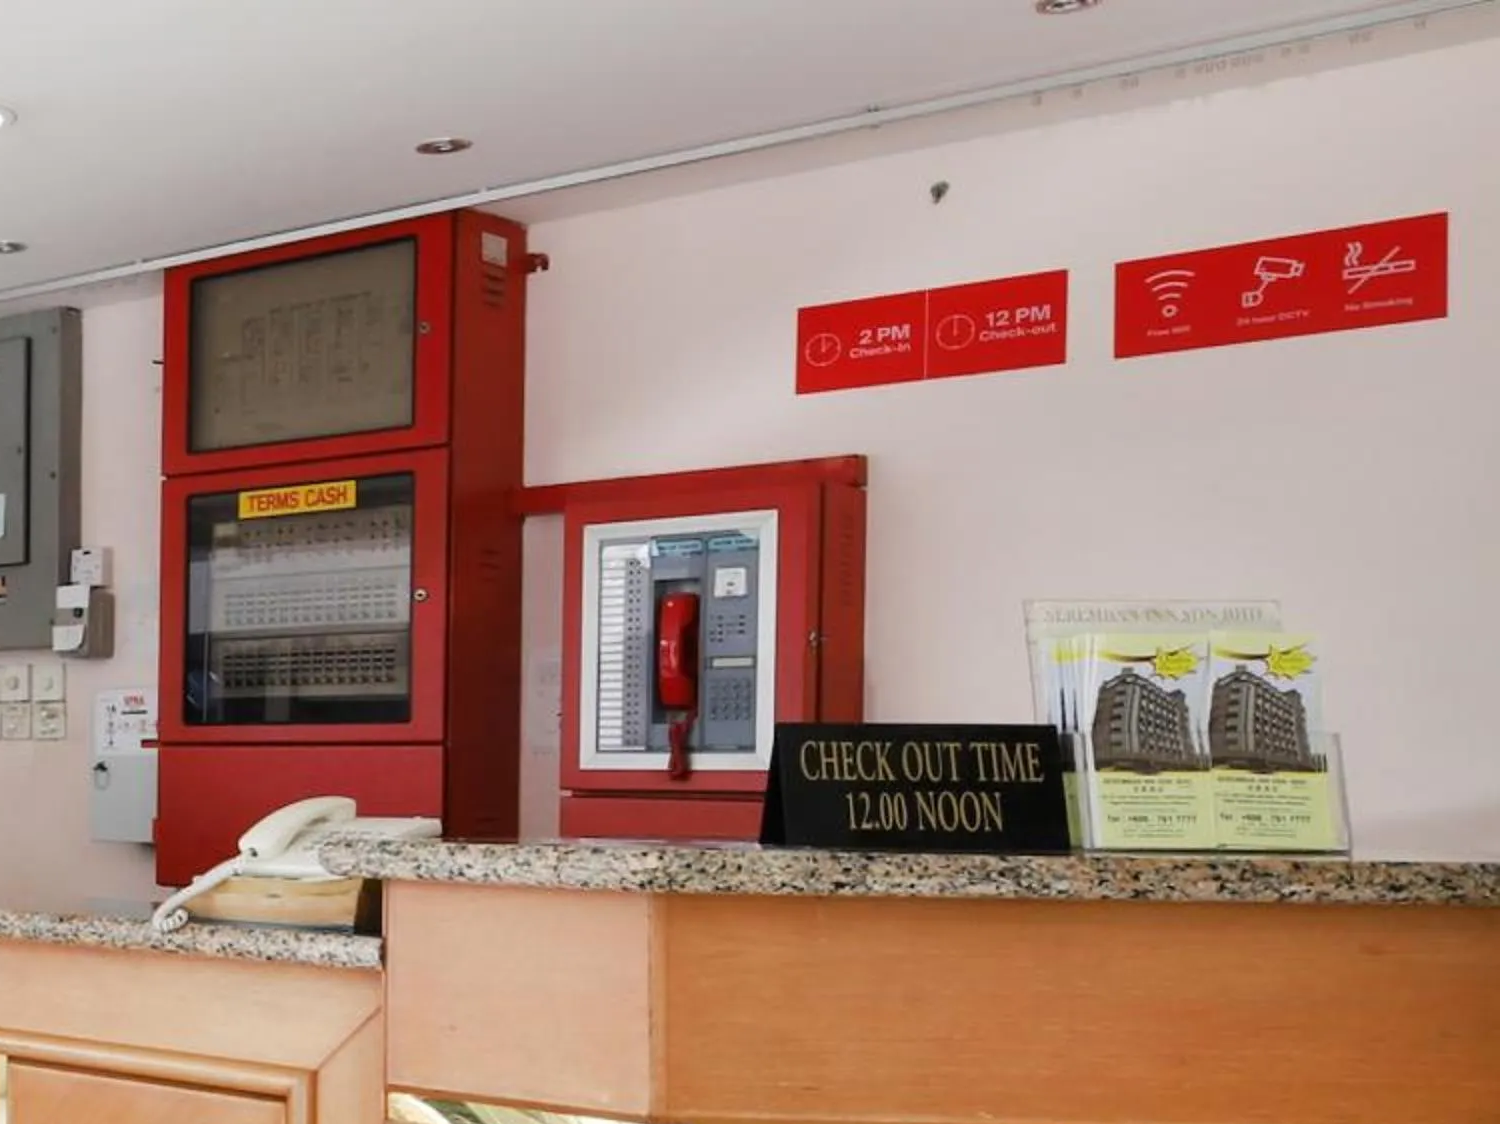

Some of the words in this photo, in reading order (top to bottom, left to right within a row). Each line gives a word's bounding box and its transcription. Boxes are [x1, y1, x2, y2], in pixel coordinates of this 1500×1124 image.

[985, 311, 1009, 327] 12
[1015, 304, 1051, 324] PM
[859, 328, 873, 345] 2
[876, 323, 911, 342] PM
[978, 324, 1058, 342] Check-out
[849, 342, 912, 360] Check-in
[247, 492, 300, 512] TERMS
[306, 486, 347, 507] CASH
[800, 740, 897, 782] CHECK
[902, 741, 963, 783] OUT
[969, 742, 1045, 784] TIME
[846, 791, 909, 831] 12.00
[916, 791, 1003, 833] NOON
